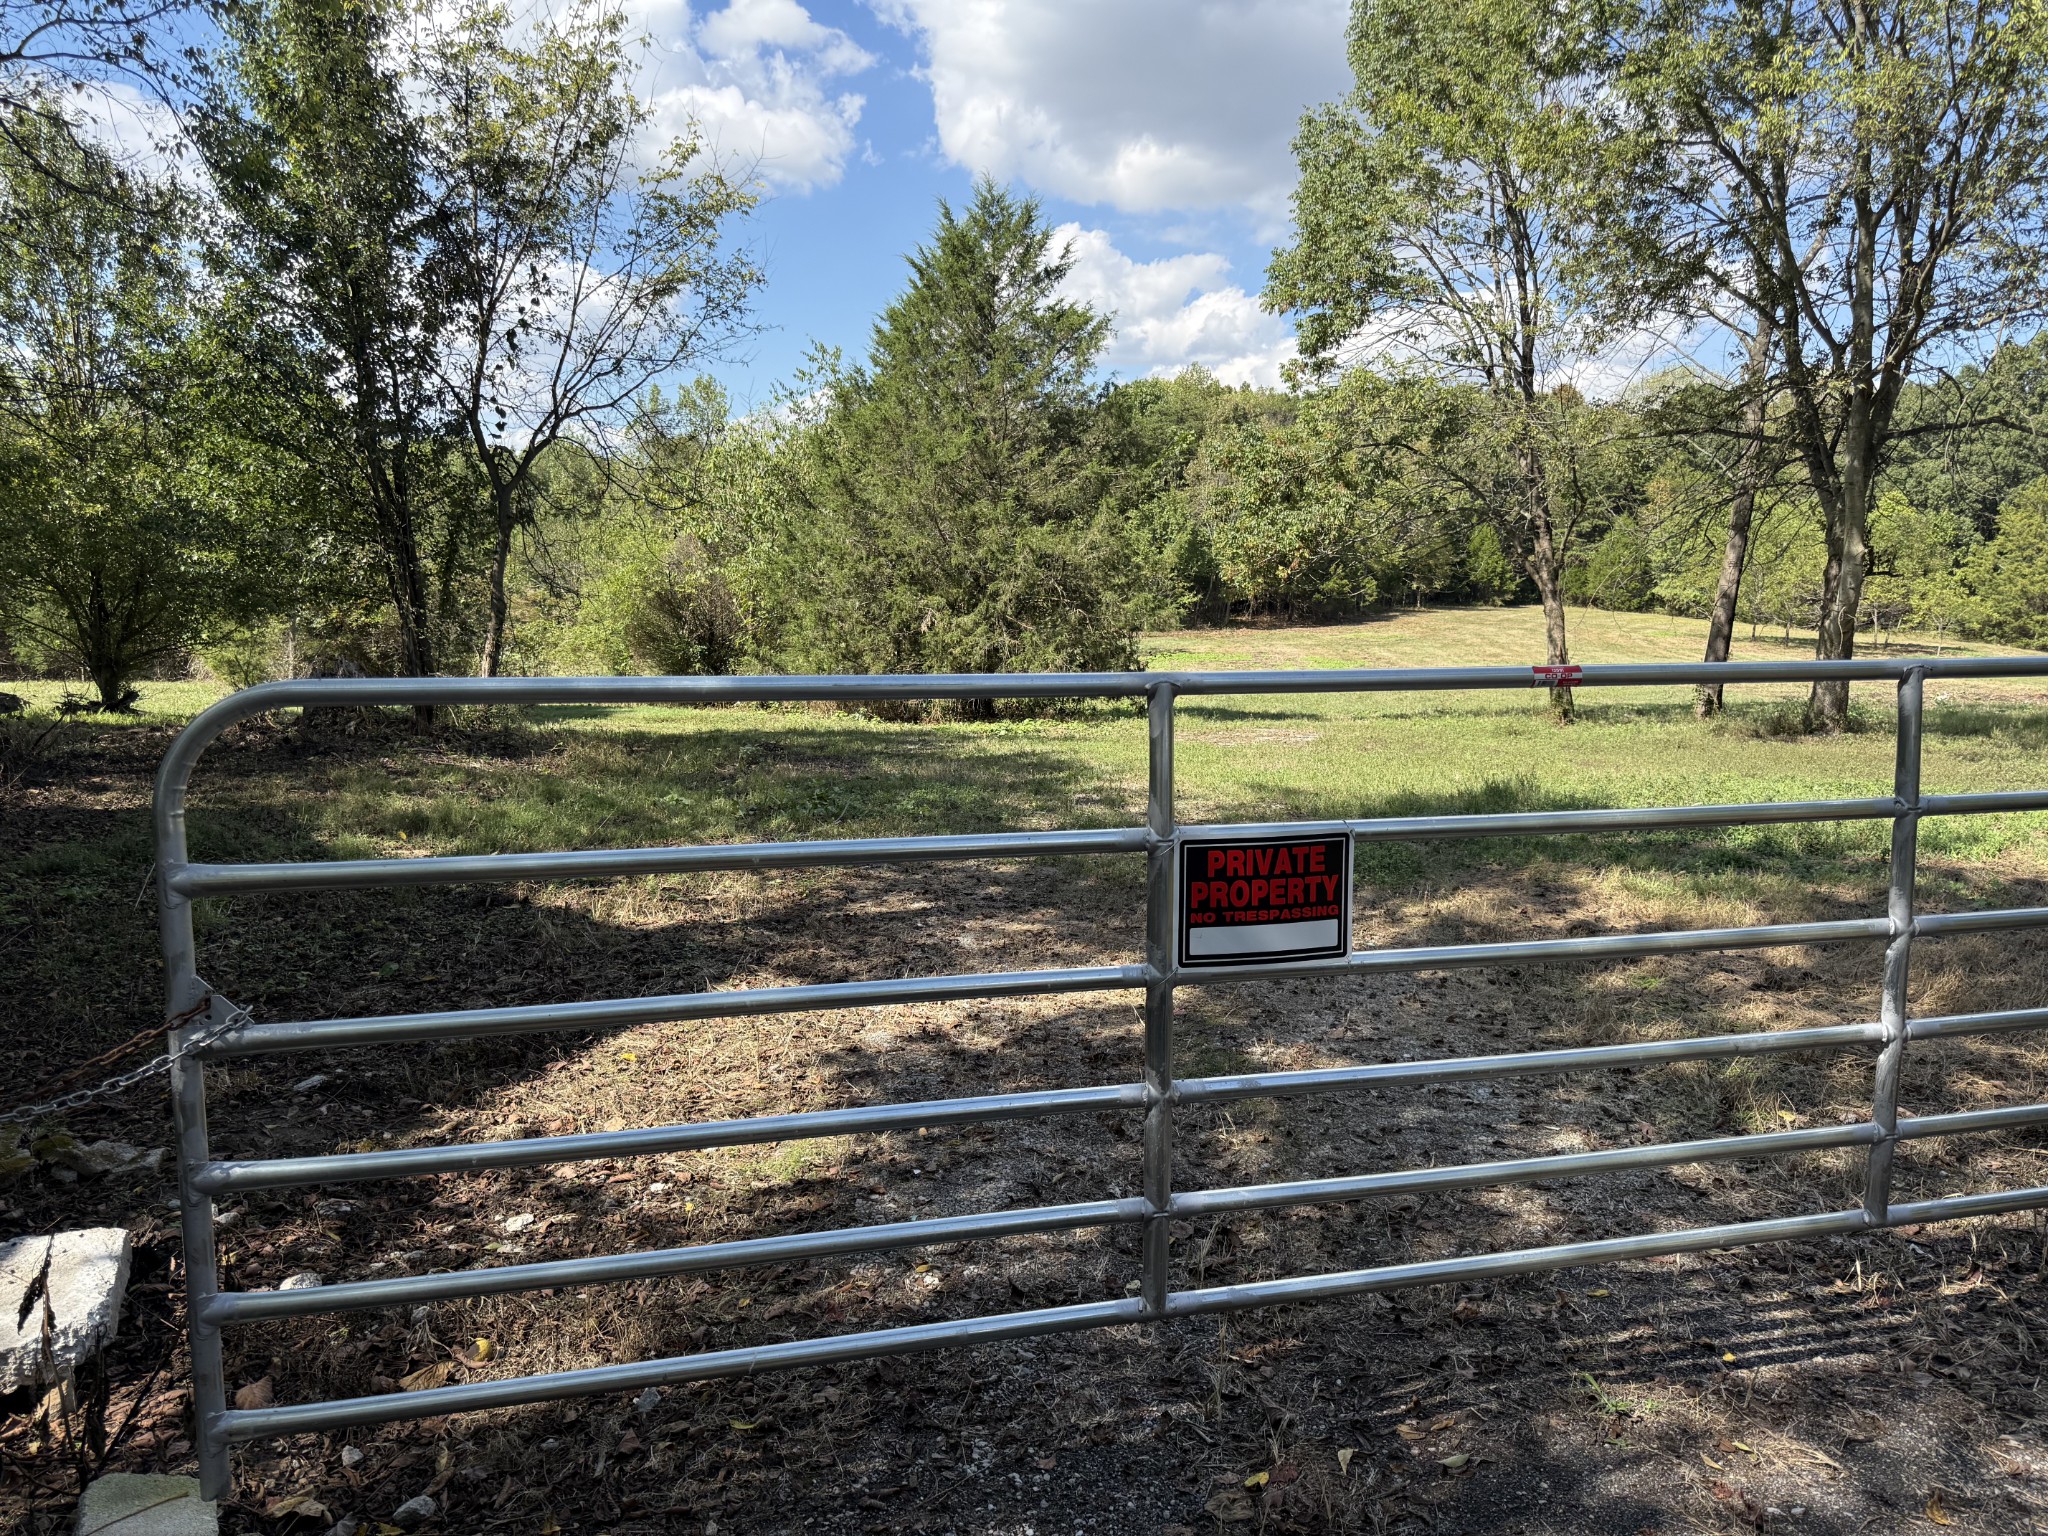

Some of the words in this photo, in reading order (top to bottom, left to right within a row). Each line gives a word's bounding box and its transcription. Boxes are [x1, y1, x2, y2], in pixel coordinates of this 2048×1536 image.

[1207, 845, 1326, 878] PRIVATE
[1190, 874, 1339, 909] PROPERTY
[1190, 912, 1217, 924] NO
[1223, 904, 1339, 923] TRESPASSING
